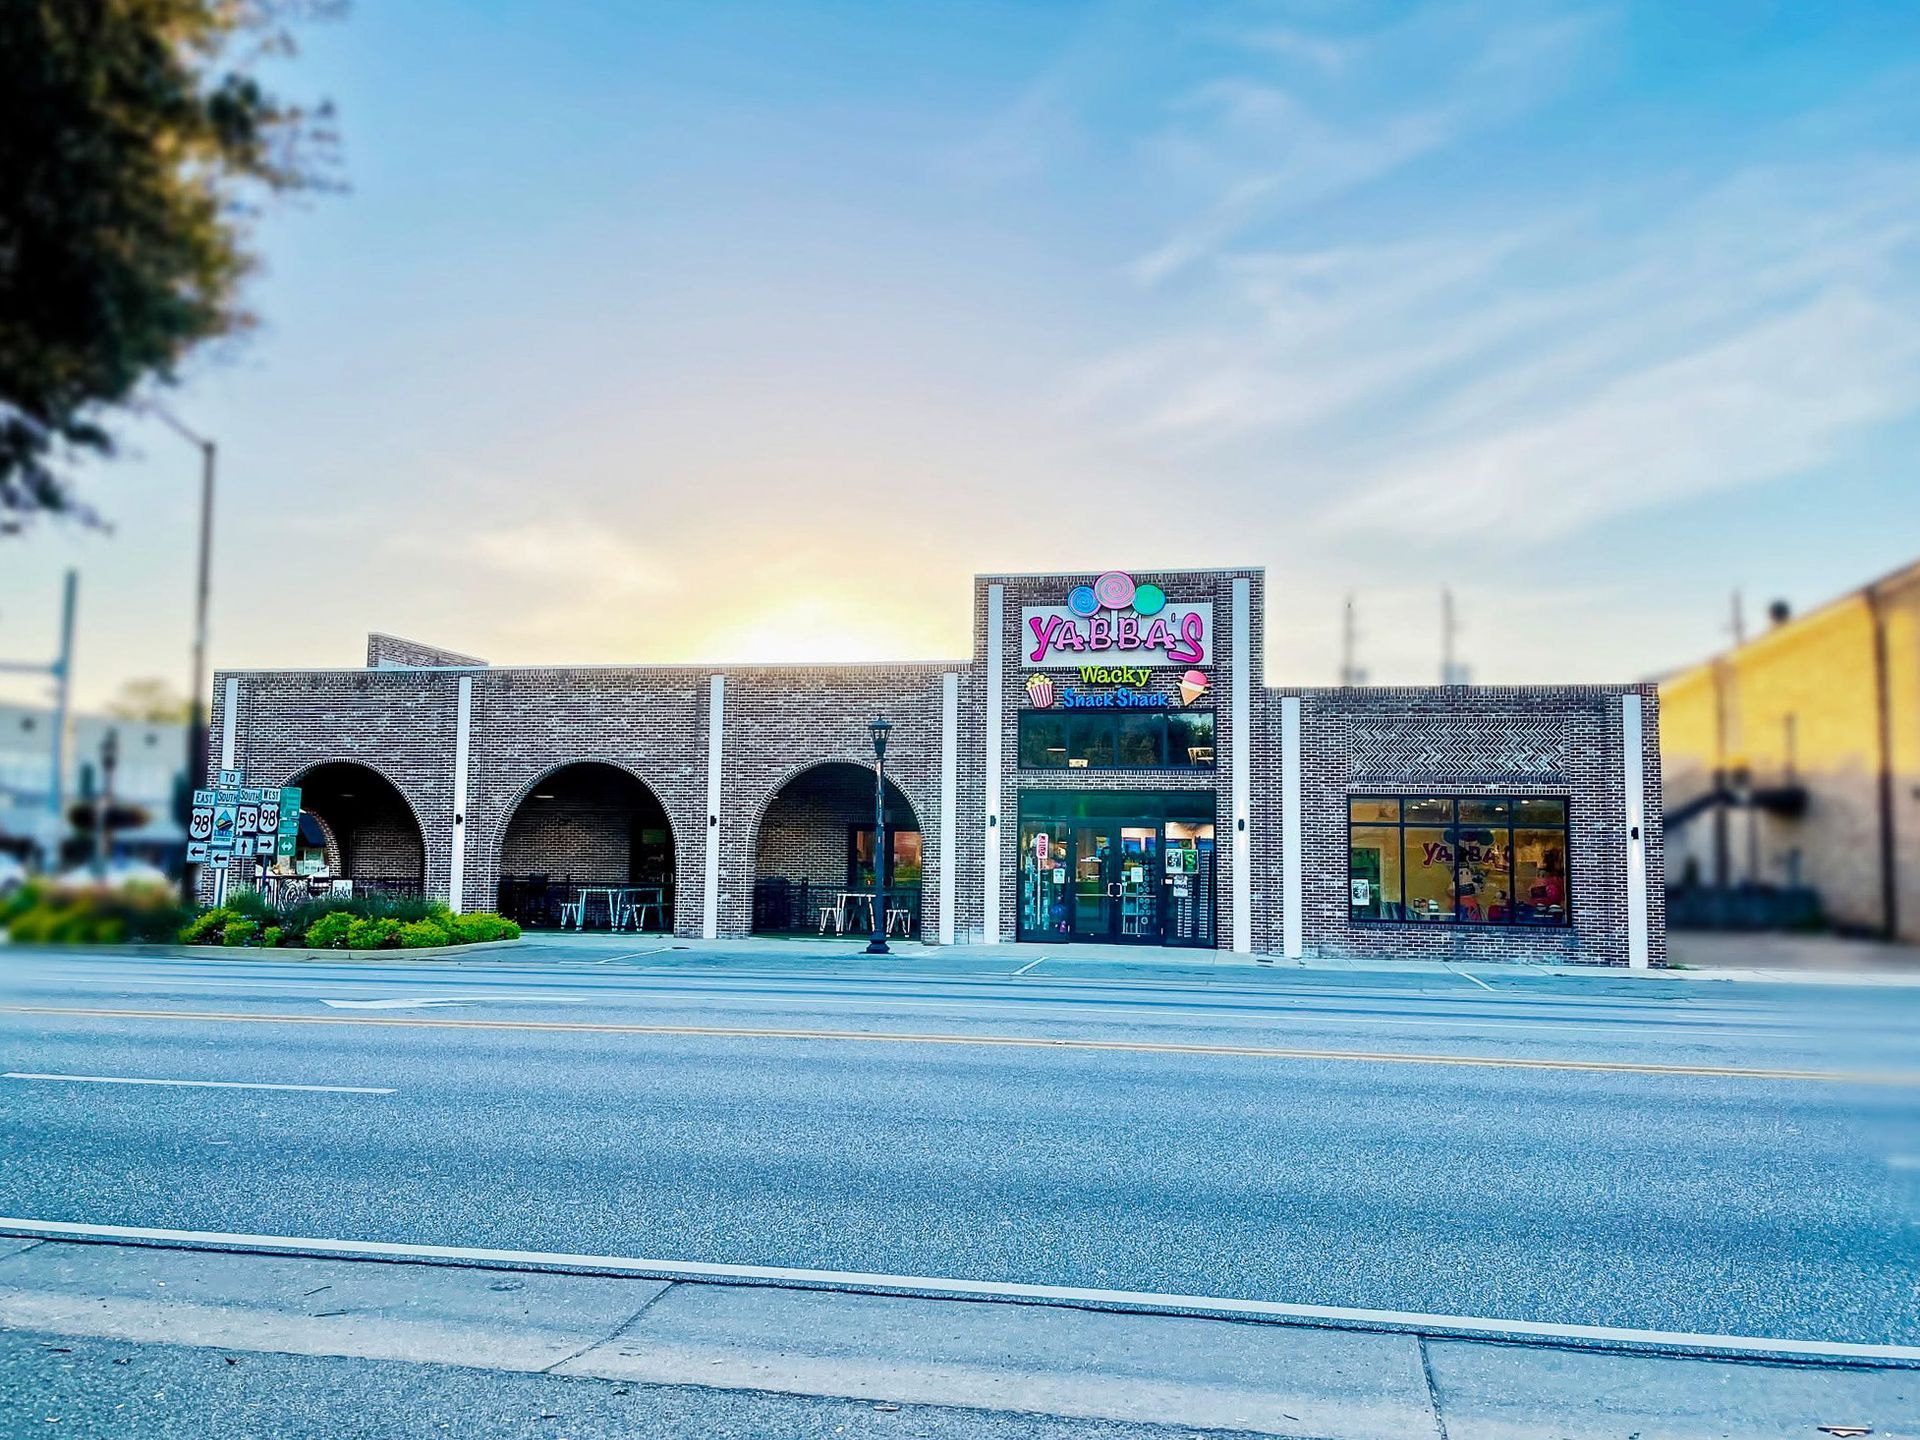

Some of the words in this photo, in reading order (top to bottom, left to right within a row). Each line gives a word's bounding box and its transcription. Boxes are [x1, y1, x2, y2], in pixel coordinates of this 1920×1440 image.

[1029, 612, 1204, 663] YABBA'S
[1078, 665, 1152, 687] Wacky
[1063, 688, 1114, 708] Snack
[1117, 687, 1169, 707] Shack
[225, 773, 236, 782] TO
[196, 792, 213, 803] EAST
[218, 791, 237, 802] SOUTH
[241, 790, 259, 801] SOUTH
[263, 789, 279, 800] WEST
[194, 815, 209, 832] 98
[238, 812, 256, 828] 59
[262, 810, 276, 826] 98
